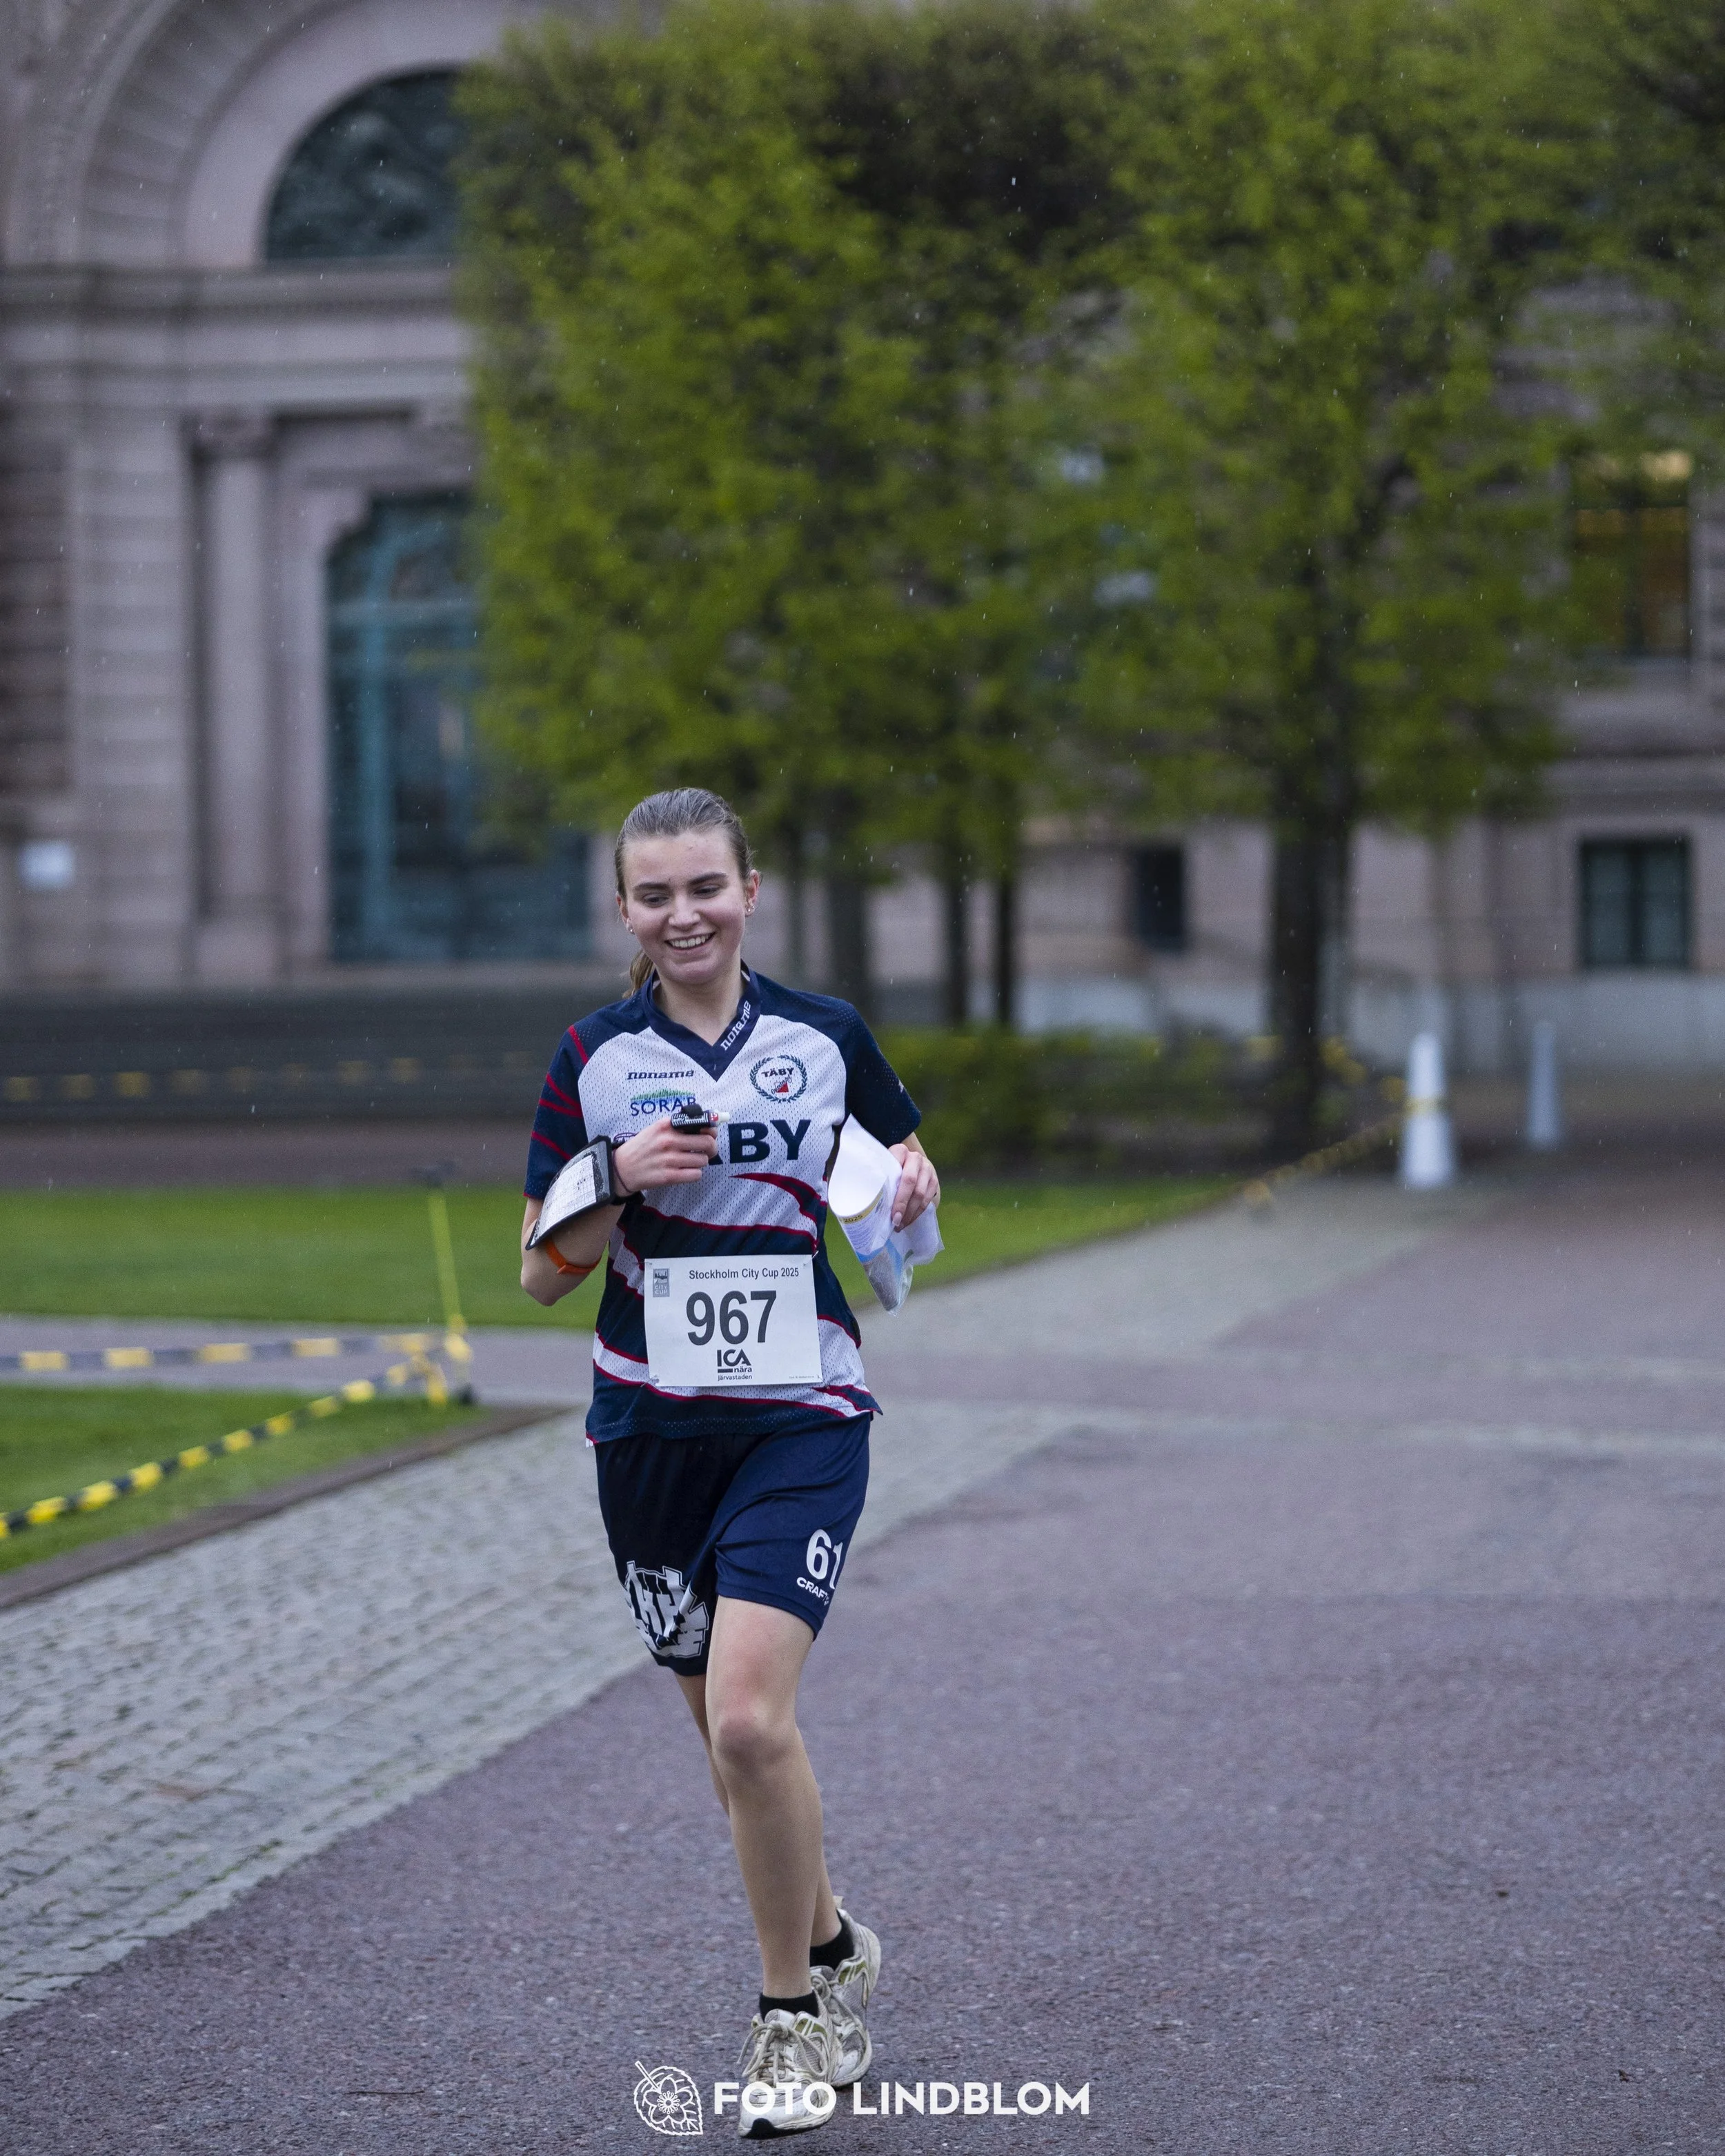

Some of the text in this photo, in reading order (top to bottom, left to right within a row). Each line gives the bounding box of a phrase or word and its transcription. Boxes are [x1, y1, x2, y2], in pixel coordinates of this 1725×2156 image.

[627, 1070, 695, 1080] noname
[761, 1067, 794, 1078] TÄBY
[709, 1119, 811, 1166] BY
[689, 1267, 799, 1280] Stockholm City Cup 2025
[686, 1290, 777, 1346] 967
[717, 1349, 751, 1367] ICA
